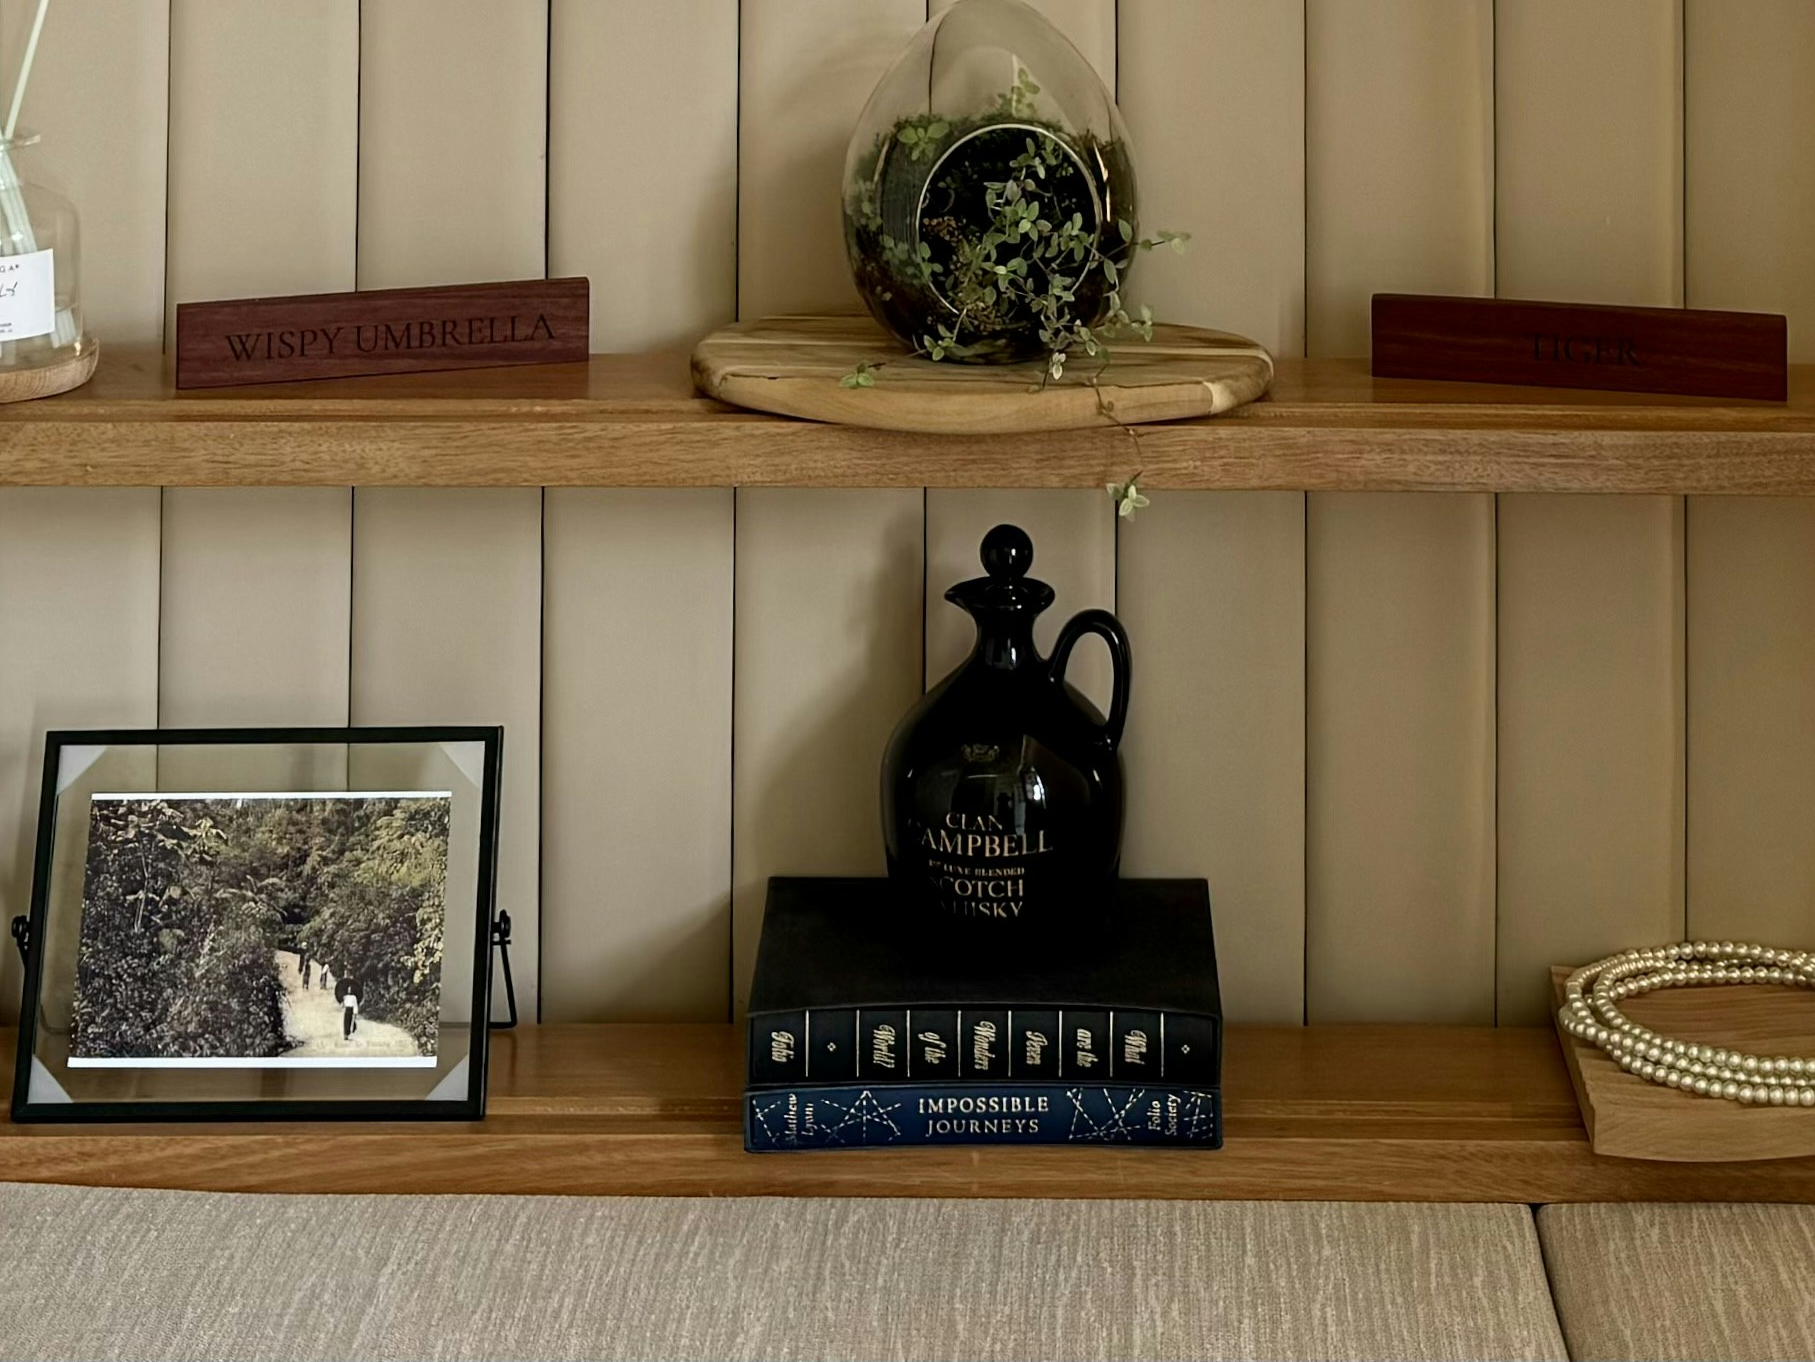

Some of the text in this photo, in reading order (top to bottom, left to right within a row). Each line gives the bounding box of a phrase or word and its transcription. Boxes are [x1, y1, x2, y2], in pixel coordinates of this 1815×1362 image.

[225, 313, 556, 362] WISPY UMBRELLA
[1525, 331, 1642, 367] TIGER
[945, 812, 1003, 831] CLAN
[916, 827, 1053, 857] AMPBELL
[974, 1021, 996, 1070] Wonders
[1077, 1029, 1092, 1050] are
[1124, 1029, 1147, 1065] What
[918, 1097, 1049, 1115] IMPOSSIBLE
[1147, 1100, 1161, 1131] Folio
[1165, 1094, 1181, 1136] Society
[926, 1118, 1040, 1136] JOURNEYS
